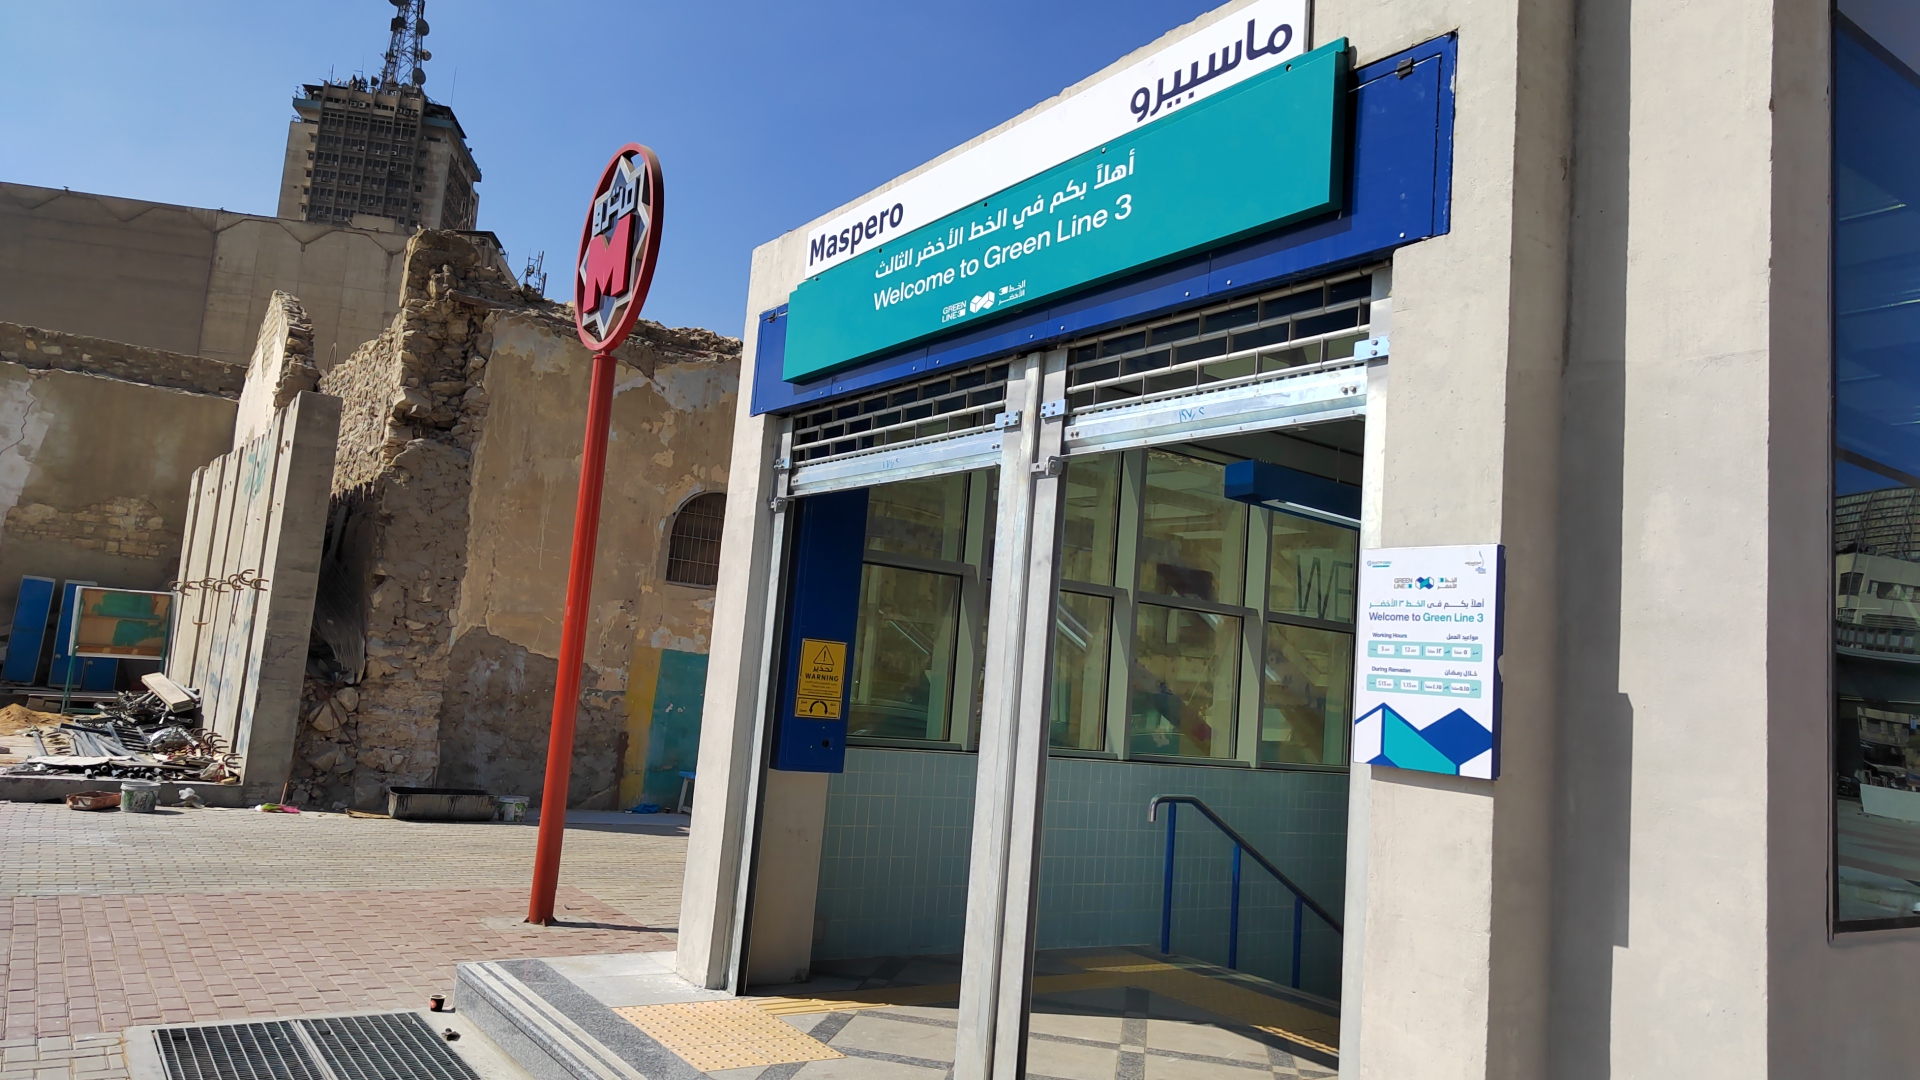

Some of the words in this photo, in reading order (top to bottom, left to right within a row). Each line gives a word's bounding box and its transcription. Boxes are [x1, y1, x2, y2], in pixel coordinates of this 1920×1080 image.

[1130, 18, 1293, 123] ماسبيرو
[1012, 194, 1044, 230] في
[1049, 179, 1087, 214] بكم
[809, 202, 904, 267] Maspero
[968, 208, 1008, 241] الخط
[583, 213, 634, 314] M
[873, 267, 955, 311] Welcome
[960, 259, 980, 279] to
[983, 230, 1051, 269] Green
[1057, 209, 1108, 243] Line
[1114, 193, 1132, 220] 3
[875, 247, 914, 279] الثالث
[915, 226, 964, 268] الأخضر
[942, 300, 967, 315] GREEN
[1369, 612, 1410, 622] Welcome
[1412, 612, 1421, 622] to
[1423, 612, 1452, 622] Green
[1454, 613, 1475, 623] Line
[1477, 613, 1484, 623] 3
[805, 673, 839, 682] WARNING
